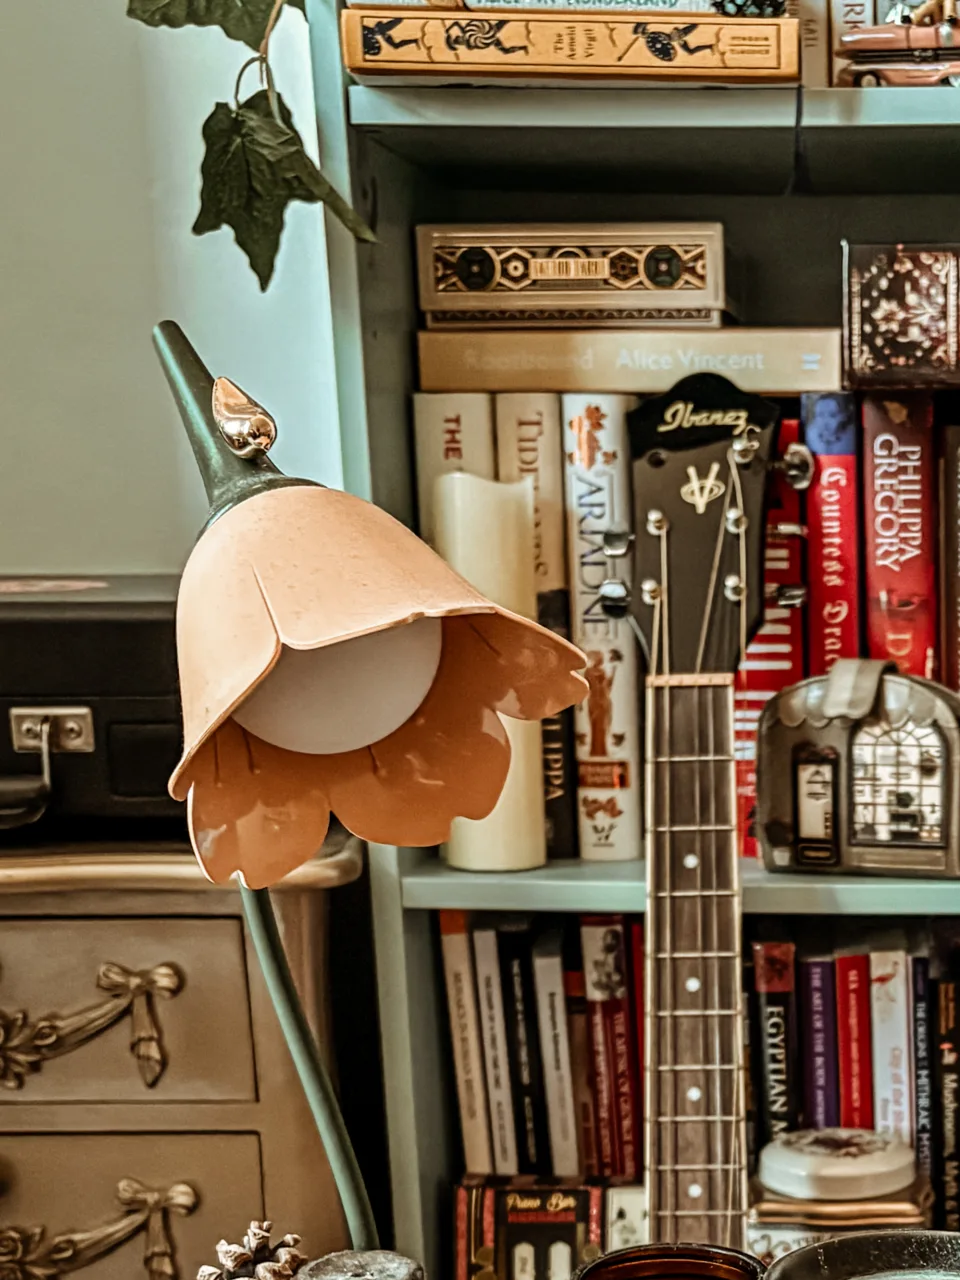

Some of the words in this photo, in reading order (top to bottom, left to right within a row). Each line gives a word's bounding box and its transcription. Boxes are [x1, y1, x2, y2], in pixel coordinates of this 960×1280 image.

[552, 32, 565, 53] The
[583, 28, 598, 58] Virgil
[615, 347, 673, 370] Alice
[678, 347, 765, 371] Vincent
[444, 414, 463, 460] THE
[657, 400, 748, 435] Ibanez
[873, 433, 900, 572] GREGORY
[899, 445, 921, 562] PHILIPPA
[820, 466, 848, 586] Countess
[766, 1005, 788, 1113] EGYPTIAN
[917, 1070, 931, 1129] MITHRAIC
[507, 1193, 541, 1209] Piano
[547, 1192, 577, 1211] Bar
